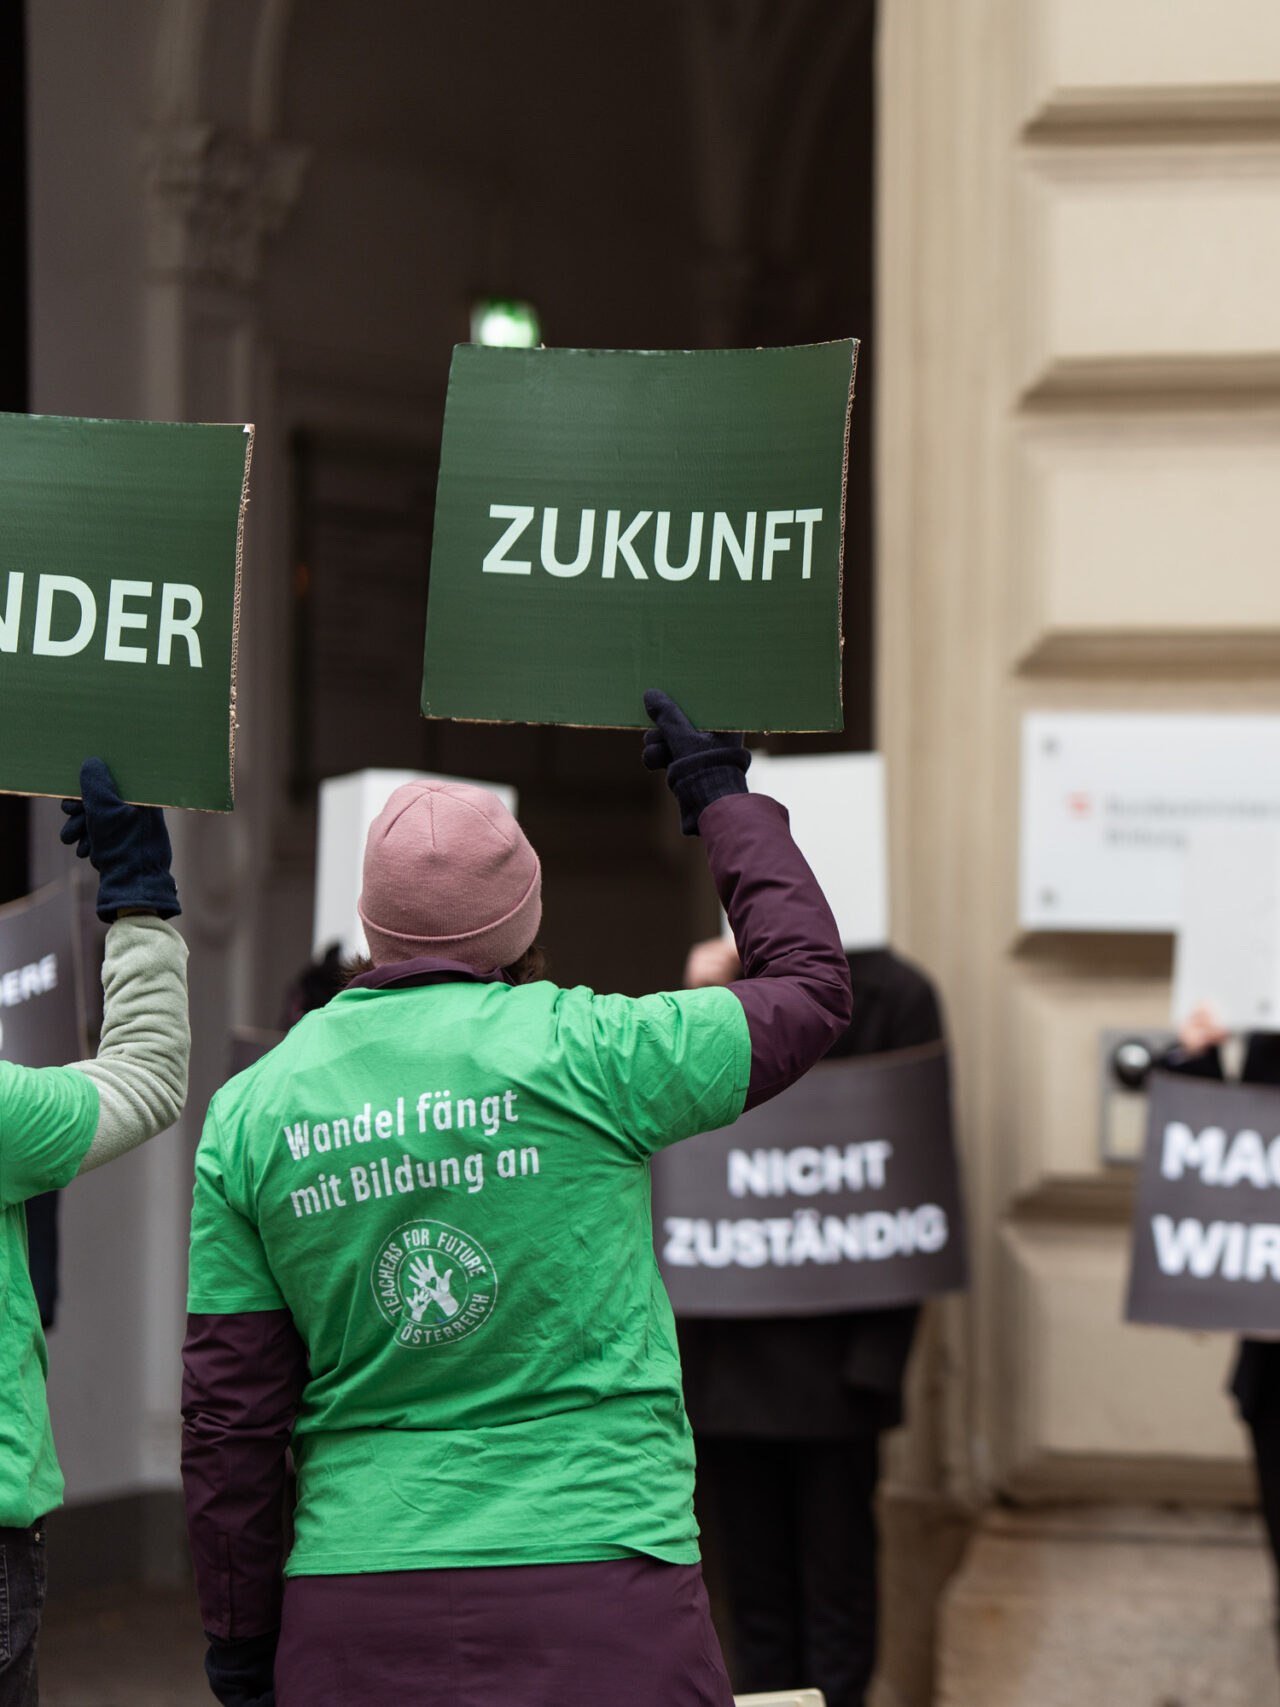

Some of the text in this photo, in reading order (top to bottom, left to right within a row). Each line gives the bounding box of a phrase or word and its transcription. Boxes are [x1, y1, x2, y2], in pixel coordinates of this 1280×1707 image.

[482, 503, 823, 581] ZUKUNFT
[283, 1089, 519, 1161] Wandel fängt
[290, 1146, 540, 1218] mit Bildung an
[728, 1140, 892, 1198] NICHT
[663, 1203, 948, 1268] ZUSTÄNDIG
[378, 1228, 487, 1317] TEACHERS FOR FUTURE
[400, 1293, 490, 1344] ÖSTERREICH
